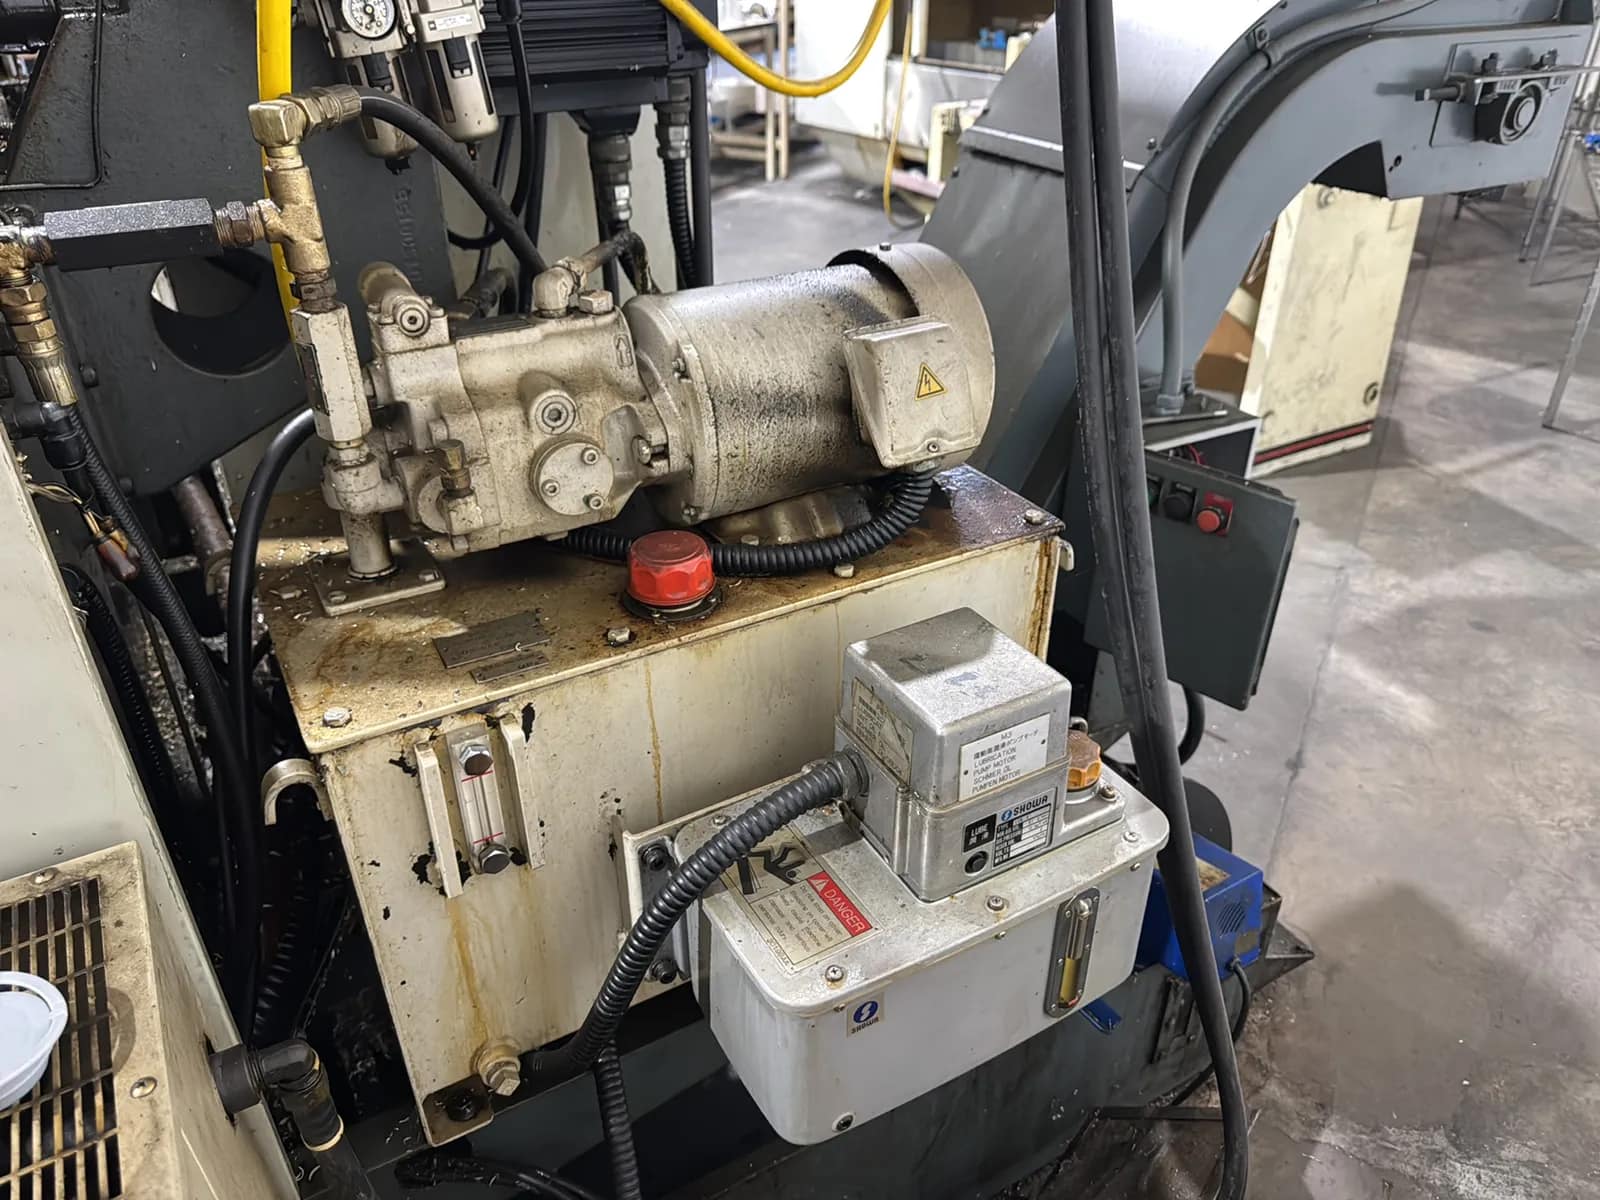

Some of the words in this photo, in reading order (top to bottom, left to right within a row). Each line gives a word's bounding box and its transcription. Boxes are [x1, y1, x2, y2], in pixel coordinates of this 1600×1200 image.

[974, 746, 1017, 768] LUBRICATION
[993, 754, 1017, 768] MOTOR
[1013, 795, 1048, 817] SHOWA
[823, 889, 865, 932] DANGER
